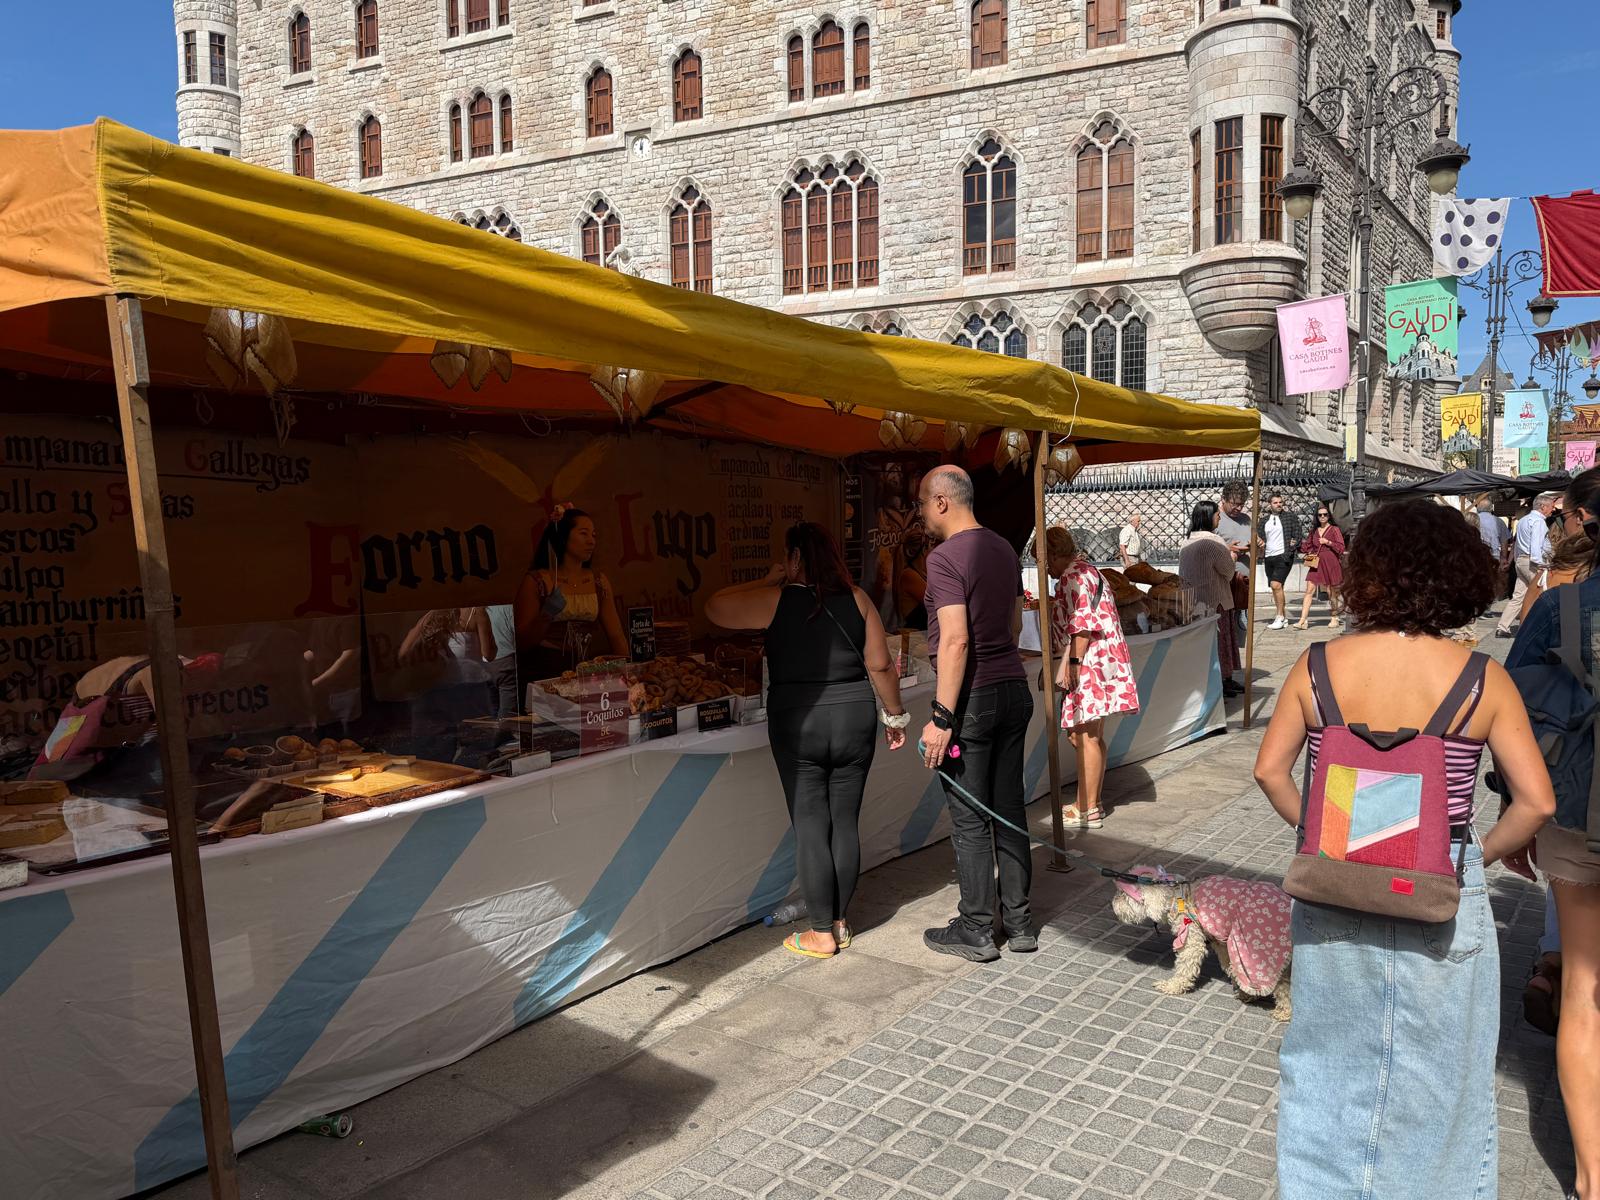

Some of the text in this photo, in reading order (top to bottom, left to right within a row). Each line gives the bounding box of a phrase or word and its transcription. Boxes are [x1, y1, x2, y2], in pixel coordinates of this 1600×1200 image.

[1388, 297, 1455, 338] GAUDÍ
[1310, 347, 1343, 358] BOTINES
[1441, 405, 1480, 427] GAUDÍ
[184, 438, 311, 492] Gallegas
[0, 478, 196, 536] ollo y Sas
[0, 526, 77, 554] scos
[294, 491, 717, 615] Forno Lugo
[0, 556, 65, 600] ulpo
[0, 586, 182, 628] amburriñs
[0, 624, 98, 678] egetal
[186, 684, 270, 718] recos
[586, 707, 625, 726] Coquitos
[600, 691, 610, 711] 6
[643, 716, 673, 729] COQUITOS
